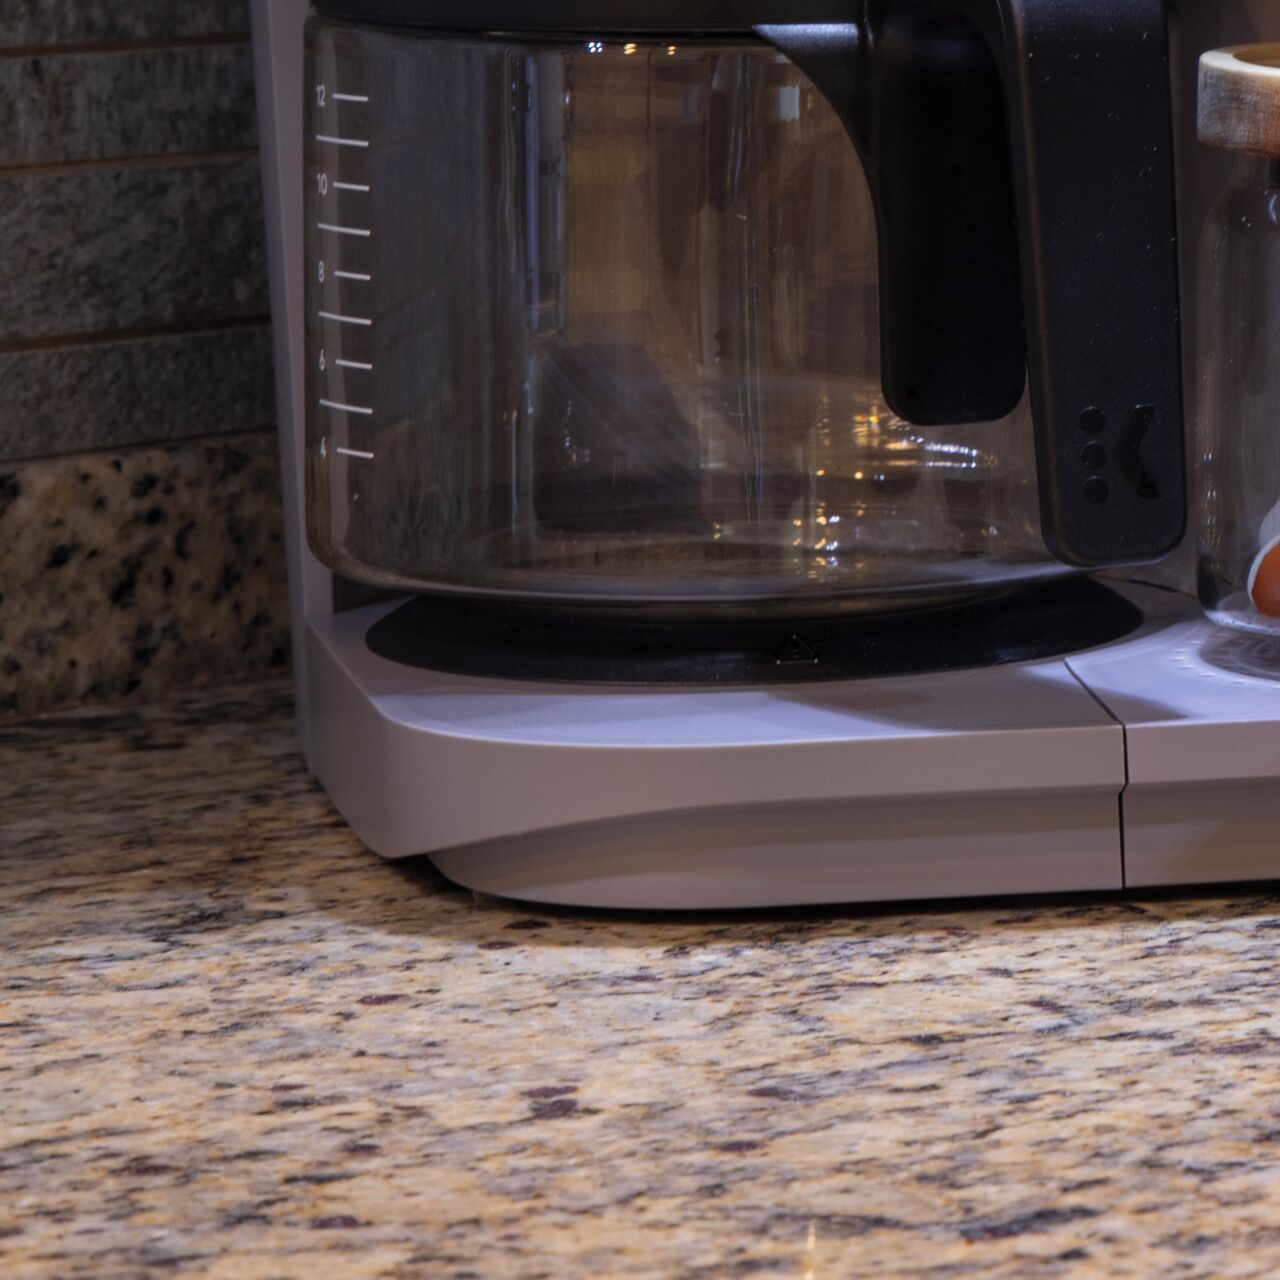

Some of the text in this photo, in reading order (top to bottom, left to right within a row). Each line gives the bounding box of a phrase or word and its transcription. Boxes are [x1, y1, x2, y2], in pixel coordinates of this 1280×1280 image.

[316, 85, 326, 107] 12
[317, 173, 328, 195] 10
[318, 261, 325, 283] 8
[319, 349, 326, 371] 6
[319, 437, 327, 458] 4
